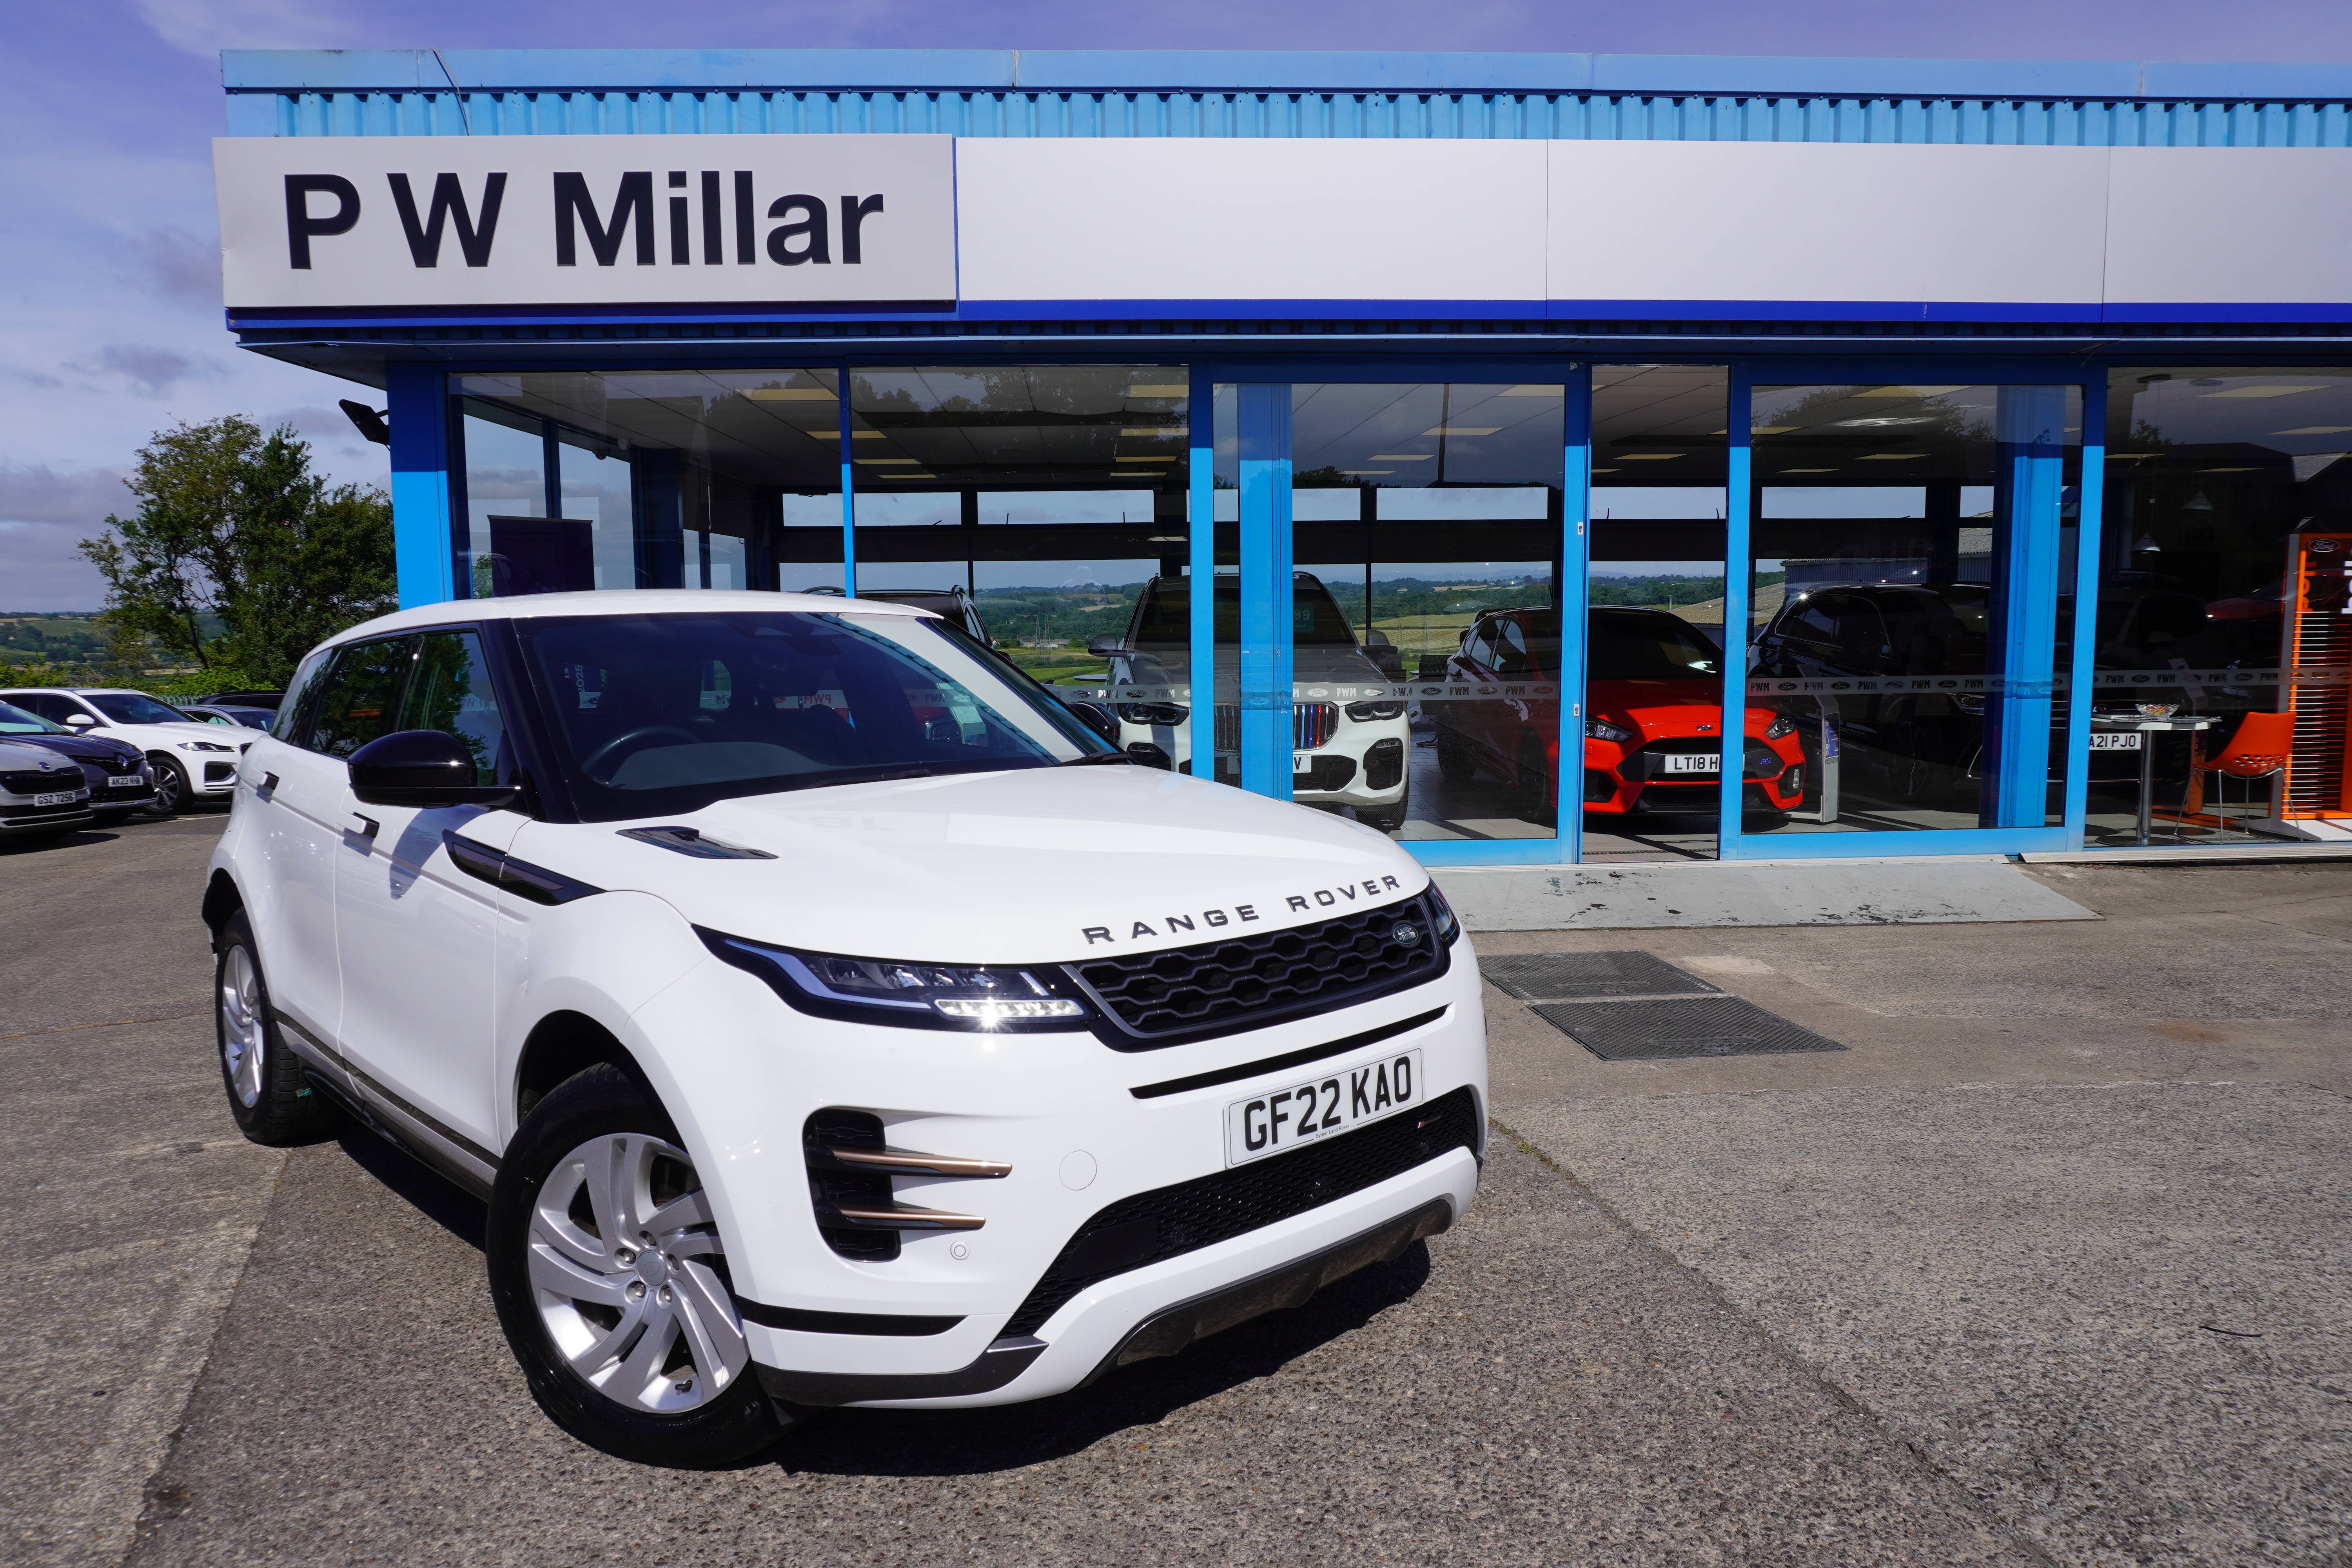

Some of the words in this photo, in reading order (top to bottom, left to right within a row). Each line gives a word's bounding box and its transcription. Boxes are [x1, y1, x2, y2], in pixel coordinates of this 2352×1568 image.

[283, 173, 361, 270] P
[387, 172, 508, 268] W
[553, 170, 884, 267] Millar
[2314, 540, 2336, 550] Ford
[2106, 675, 2124, 683] PWM
[2157, 674, 2176, 683] PWM
[1750, 682, 1769, 691] PWM
[1858, 681, 1877, 690] PWM
[1911, 680, 1930, 689] PWM
[1964, 679, 1984, 688] PWM
[1155, 689, 1175, 698] PWM
[1336, 688, 1356, 697] PWM
[1449, 686, 1469, 695] PWM
[1506, 686, 1525, 695] PWM
[2089, 735, 2108, 748] A21
[1674, 757, 1705, 770] LT18
[38, 795, 54, 804] GSZ
[1081, 904, 1259, 945] RANGE
[1285, 875, 1401, 913] ROVER
[1396, 926, 1410, 936] LAND
[1401, 931, 1417, 941] ROVER
[1244, 1078, 1341, 1152] GF22
[1351, 1056, 1412, 1119] KAO
